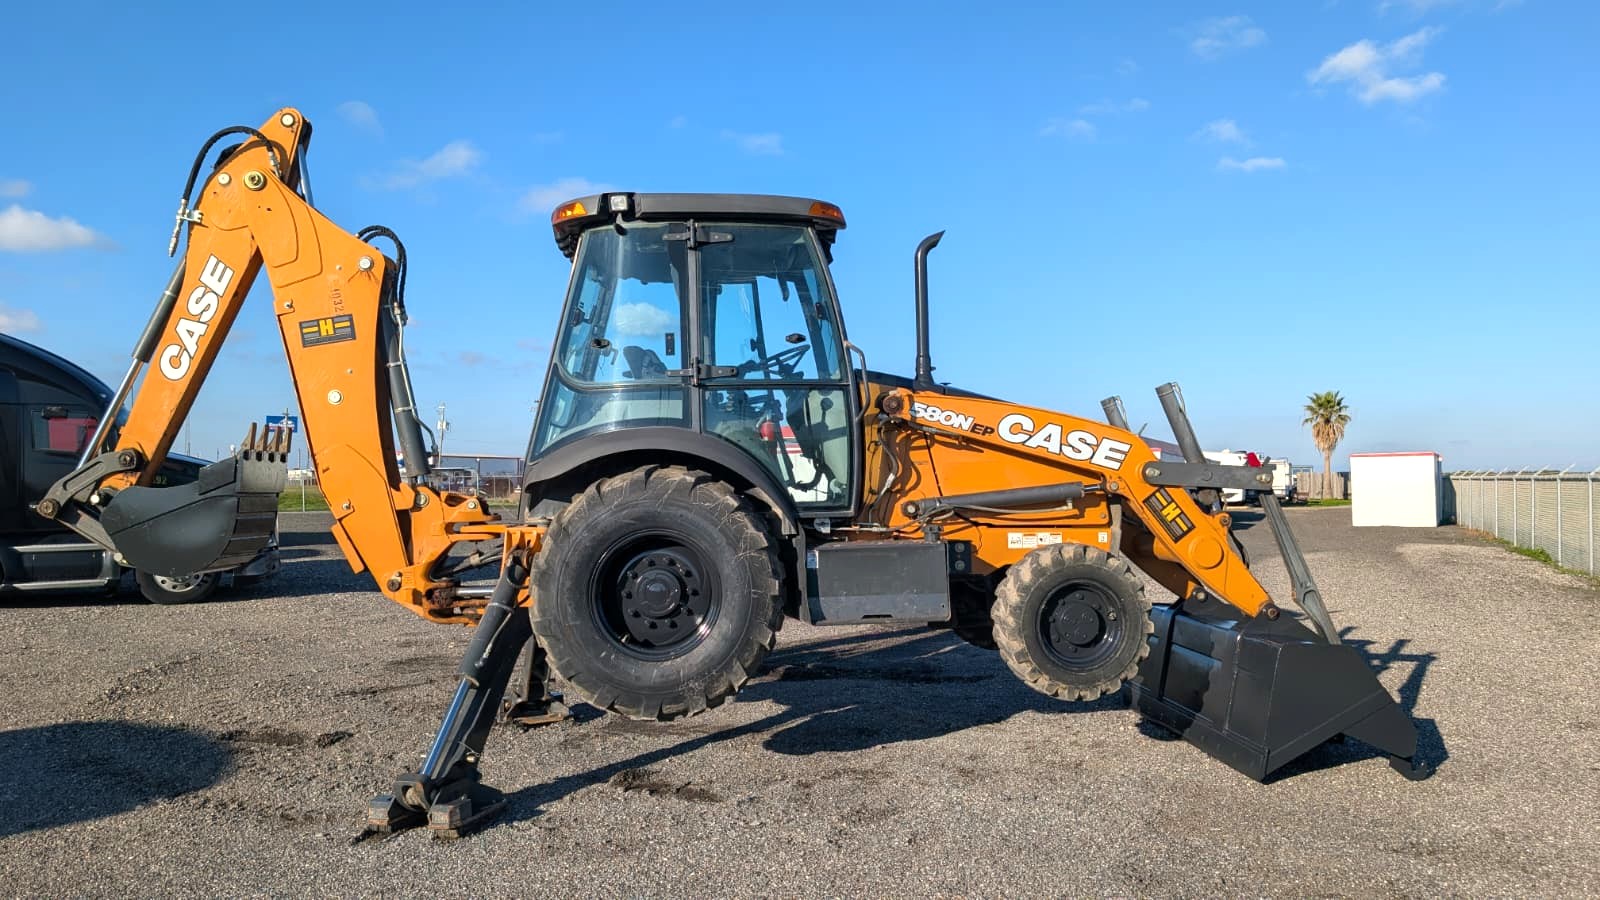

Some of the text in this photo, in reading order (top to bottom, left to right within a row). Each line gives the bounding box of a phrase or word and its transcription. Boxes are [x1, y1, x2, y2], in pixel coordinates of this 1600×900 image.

[159, 253, 235, 381] CASE
[911, 402, 995, 437] 580N EP
[997, 413, 1132, 470] CASE
